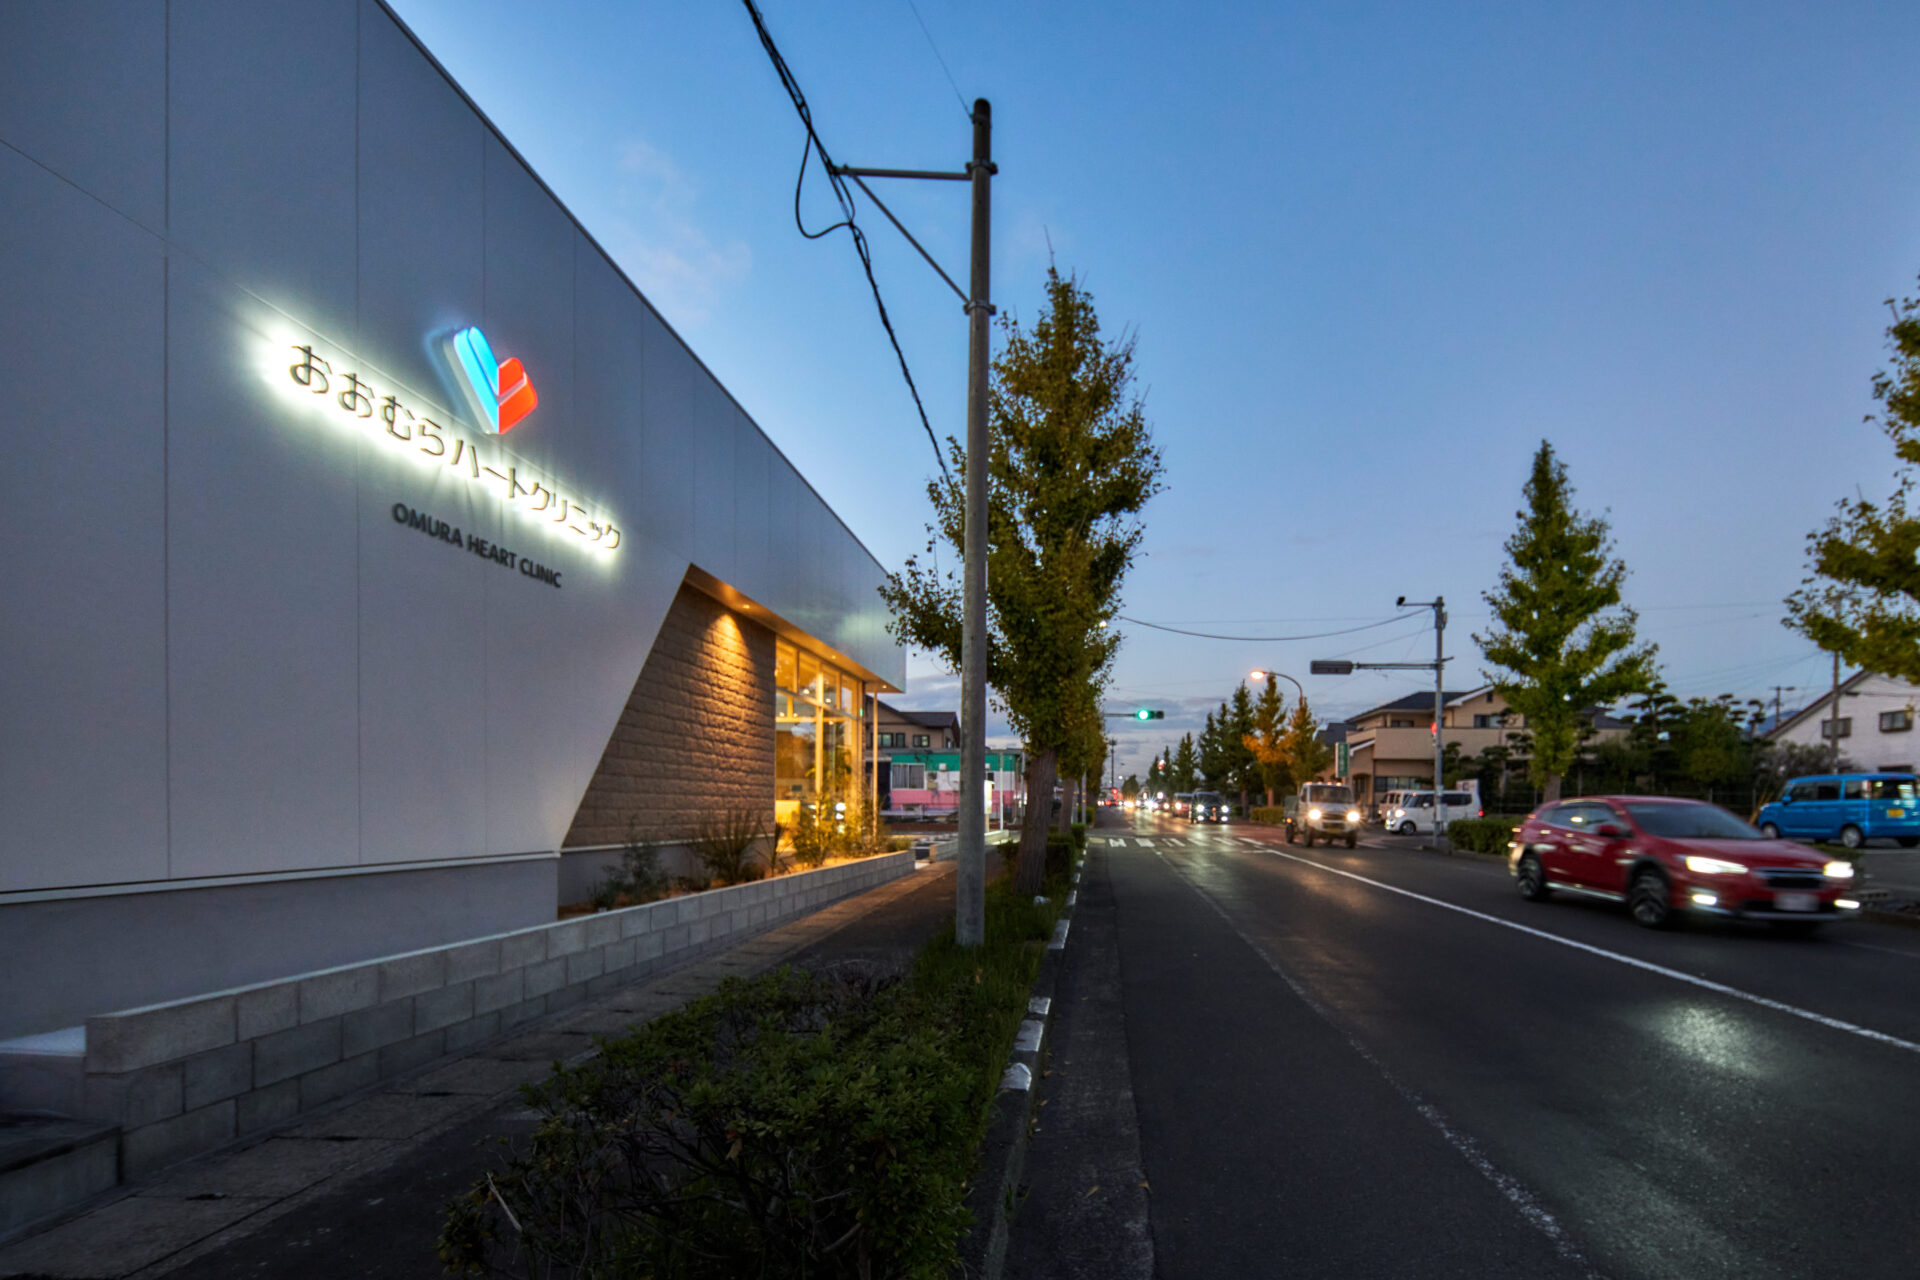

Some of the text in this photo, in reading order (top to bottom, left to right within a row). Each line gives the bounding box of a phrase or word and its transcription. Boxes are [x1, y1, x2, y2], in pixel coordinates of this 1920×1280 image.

[290, 345, 621, 549] おおむらハートクリニック
[393, 502, 562, 588] OMURA HEART CLINIC
